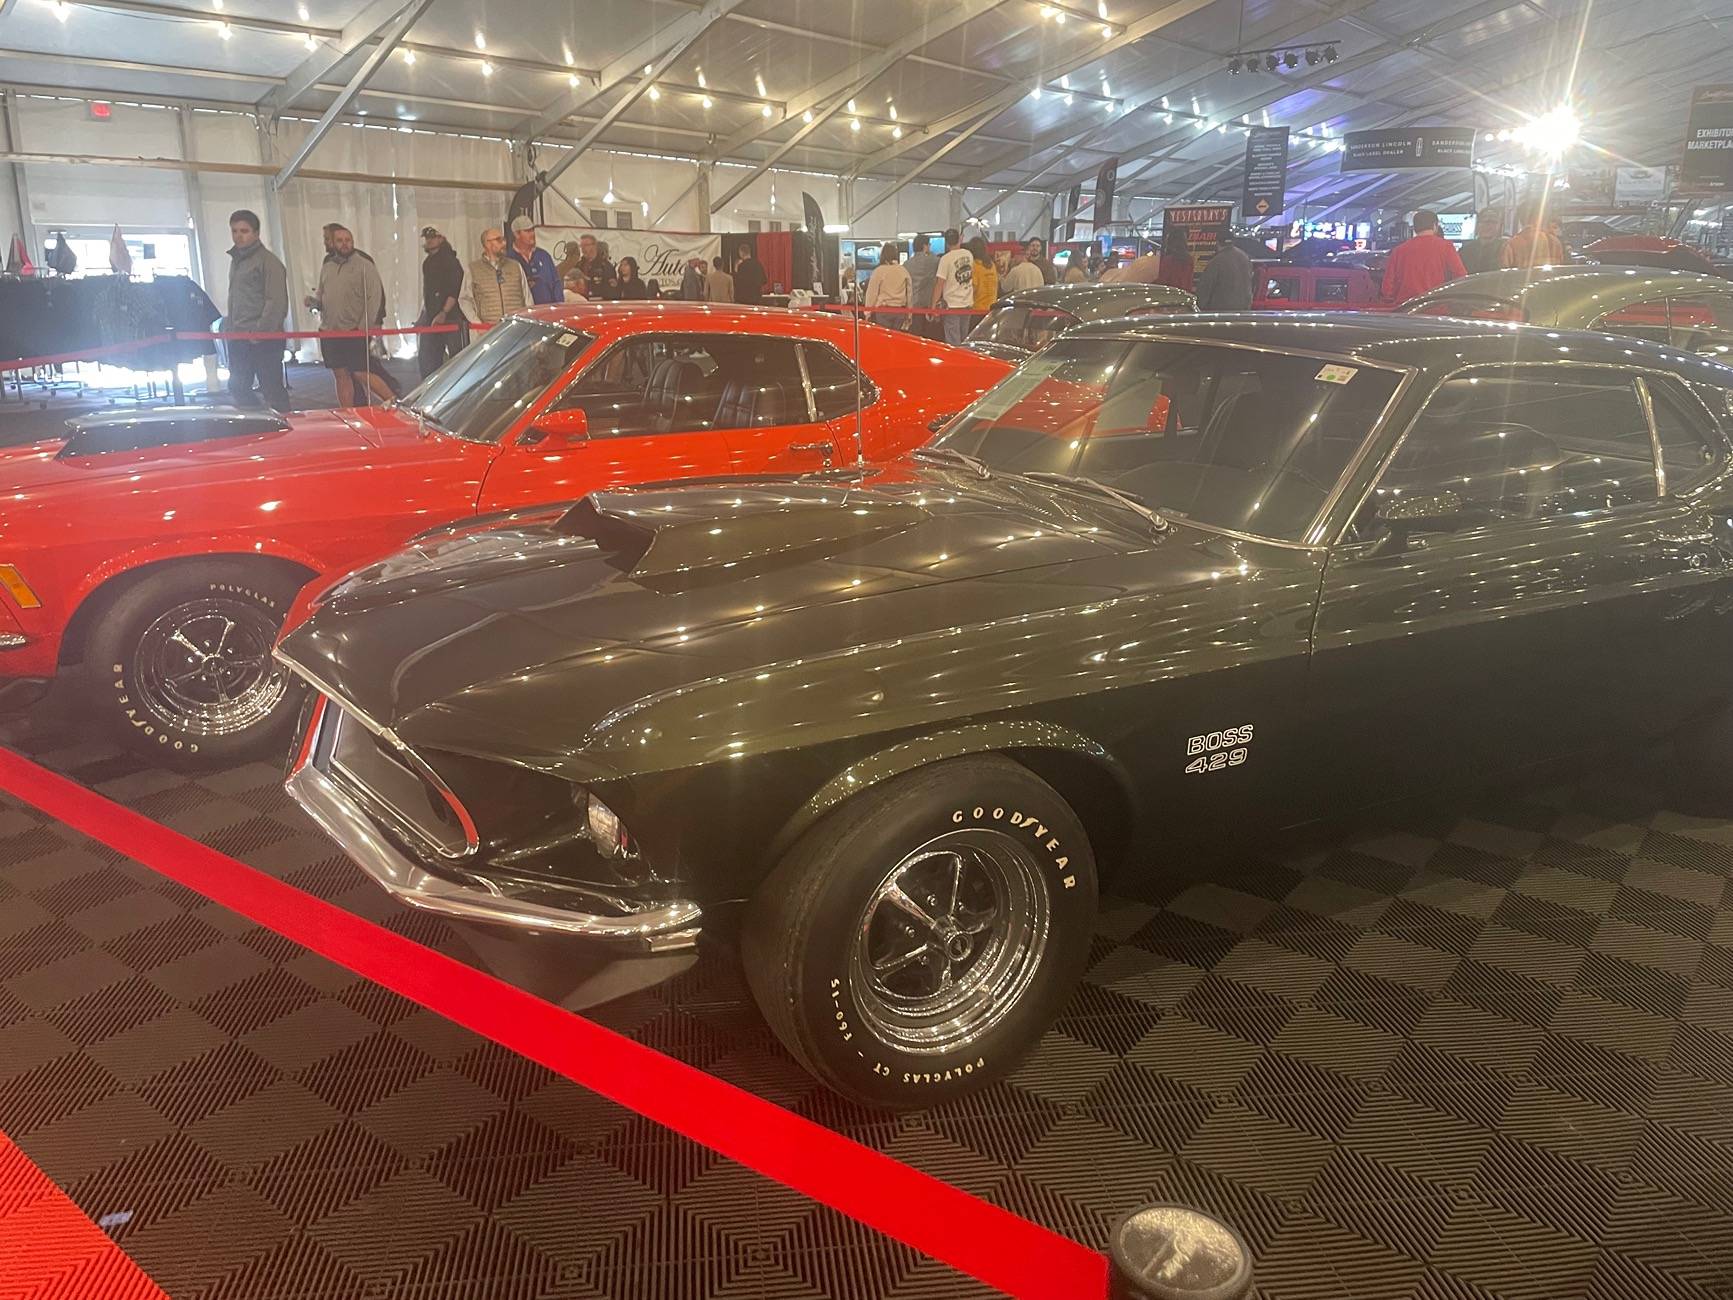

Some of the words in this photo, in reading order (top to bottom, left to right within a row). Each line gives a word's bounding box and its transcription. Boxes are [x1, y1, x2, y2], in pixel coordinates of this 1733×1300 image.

[210, 584, 275, 608] POLYGLAS
[113, 663, 199, 753] GOODYEAR
[1187, 724, 1254, 756] BOSS
[1185, 747, 1248, 774] 429
[952, 806, 1076, 889] GOODYEAR
[872, 1062, 890, 1077] CT
[903, 1057, 985, 1084] POLYGLAS
